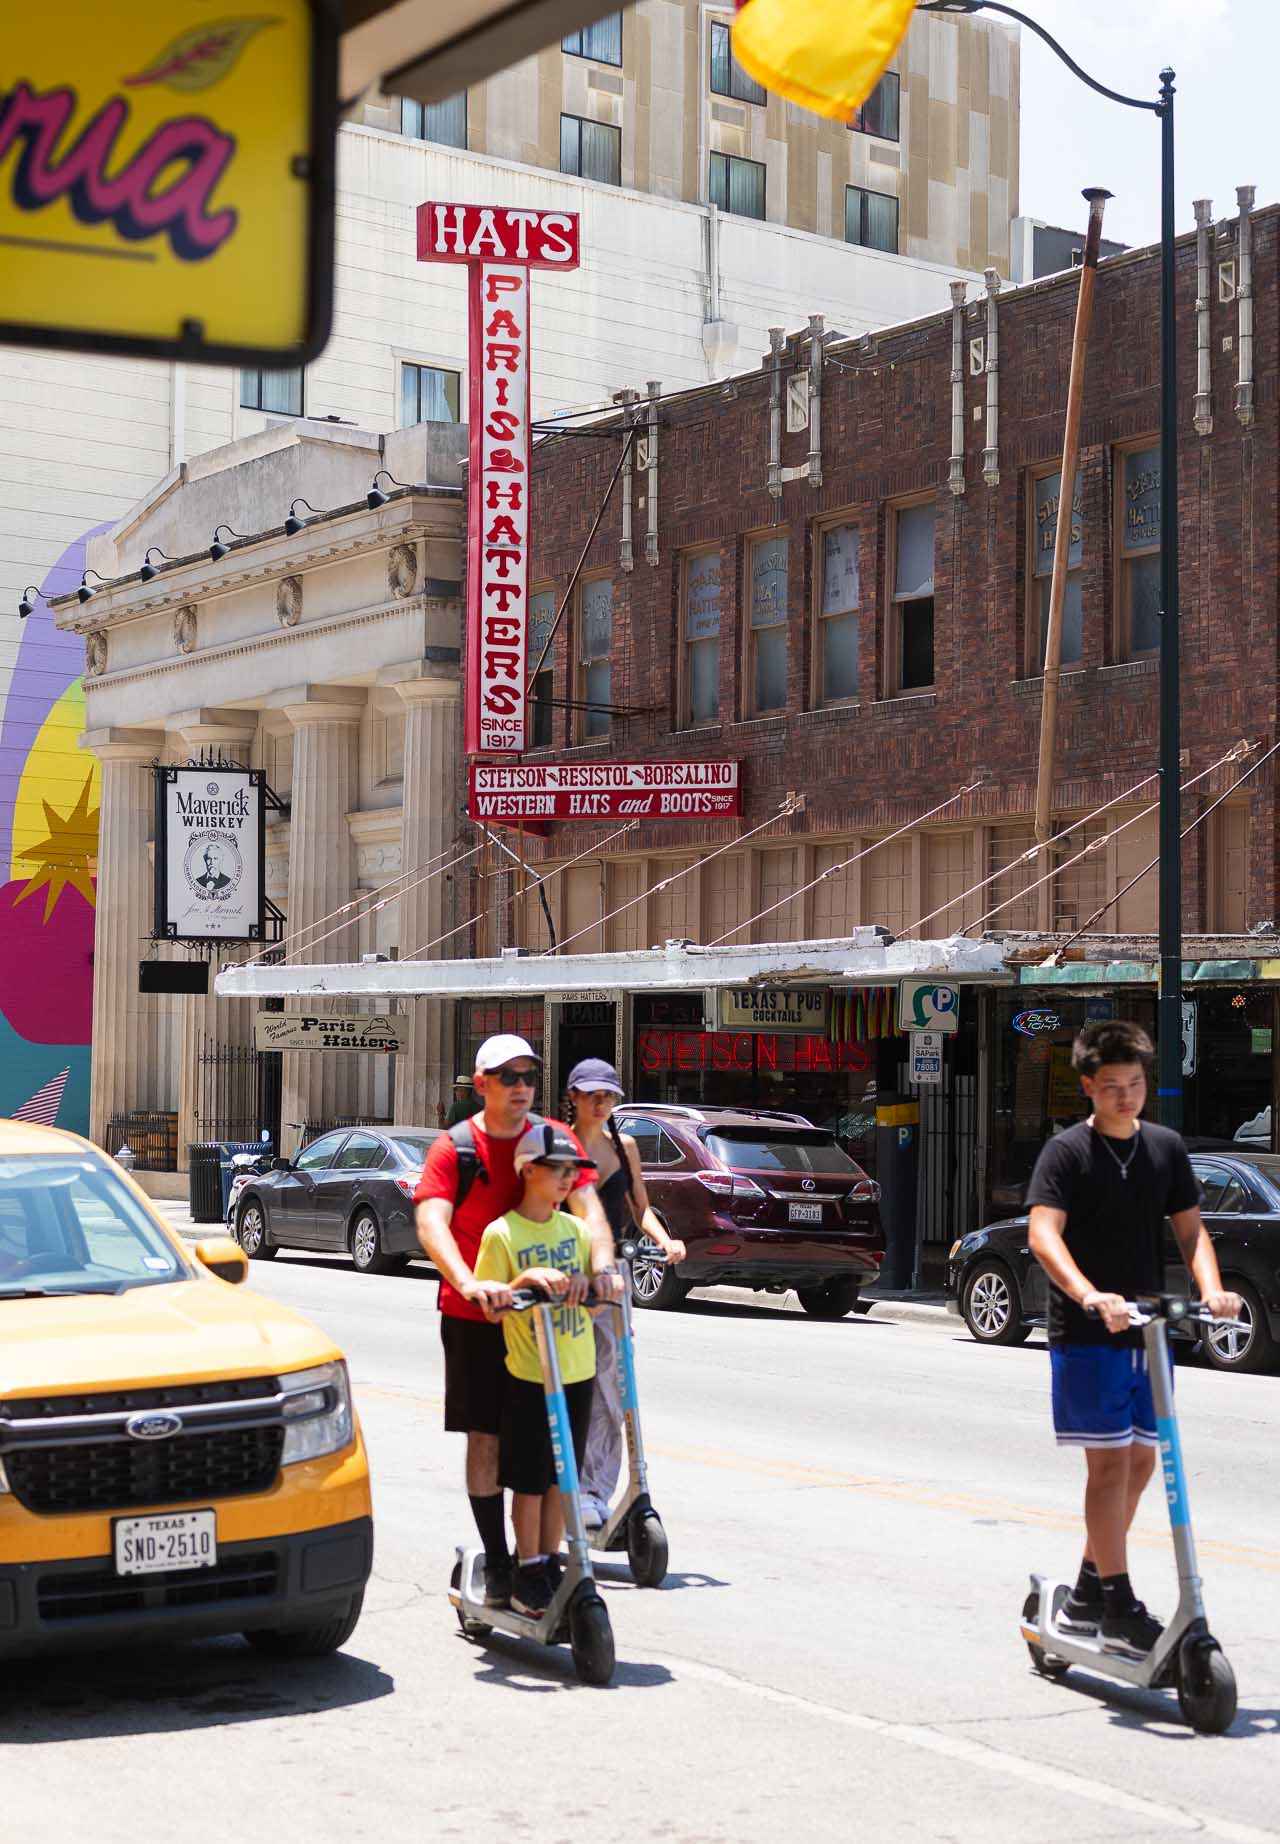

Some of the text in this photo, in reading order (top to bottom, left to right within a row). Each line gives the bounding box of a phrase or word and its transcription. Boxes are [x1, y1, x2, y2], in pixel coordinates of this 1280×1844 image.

[435, 205, 573, 262] HATS
[485, 274, 523, 442] PARIS
[482, 481, 522, 716] HATTERS
[481, 718, 522, 733] SINCE
[486, 734, 517, 748] 1917
[478, 763, 732, 789] STETSON RESISTOL BORSALINO
[175, 787, 250, 816] Maverick
[477, 791, 712, 817] WESTERN HATS and BOOTS
[711, 795, 734, 803] SINCE
[714, 802, 730, 811] 1917
[182, 815, 244, 828] WHISKEY
[562, 993, 608, 1001] PARIS HATTERS
[733, 991, 822, 1010] TEXAS T PUB
[752, 1009, 802, 1022] COCKTAILS
[1027, 1013, 1059, 1022] BUD
[264, 1019, 288, 1034] World
[300, 1017, 356, 1033] Paris
[1020, 1021, 1061, 1031] LIGHT
[269, 1026, 297, 1041] Famous
[322, 1034, 399, 1051] Hatters
[640, 1033, 868, 1073] STETSON HATS
[916, 1063, 938, 1071] 78081
[517, 1244, 549, 1269] IT'S
[549, 1238, 577, 1272] NOT
[148, 1519, 185, 1531] TEXAS
